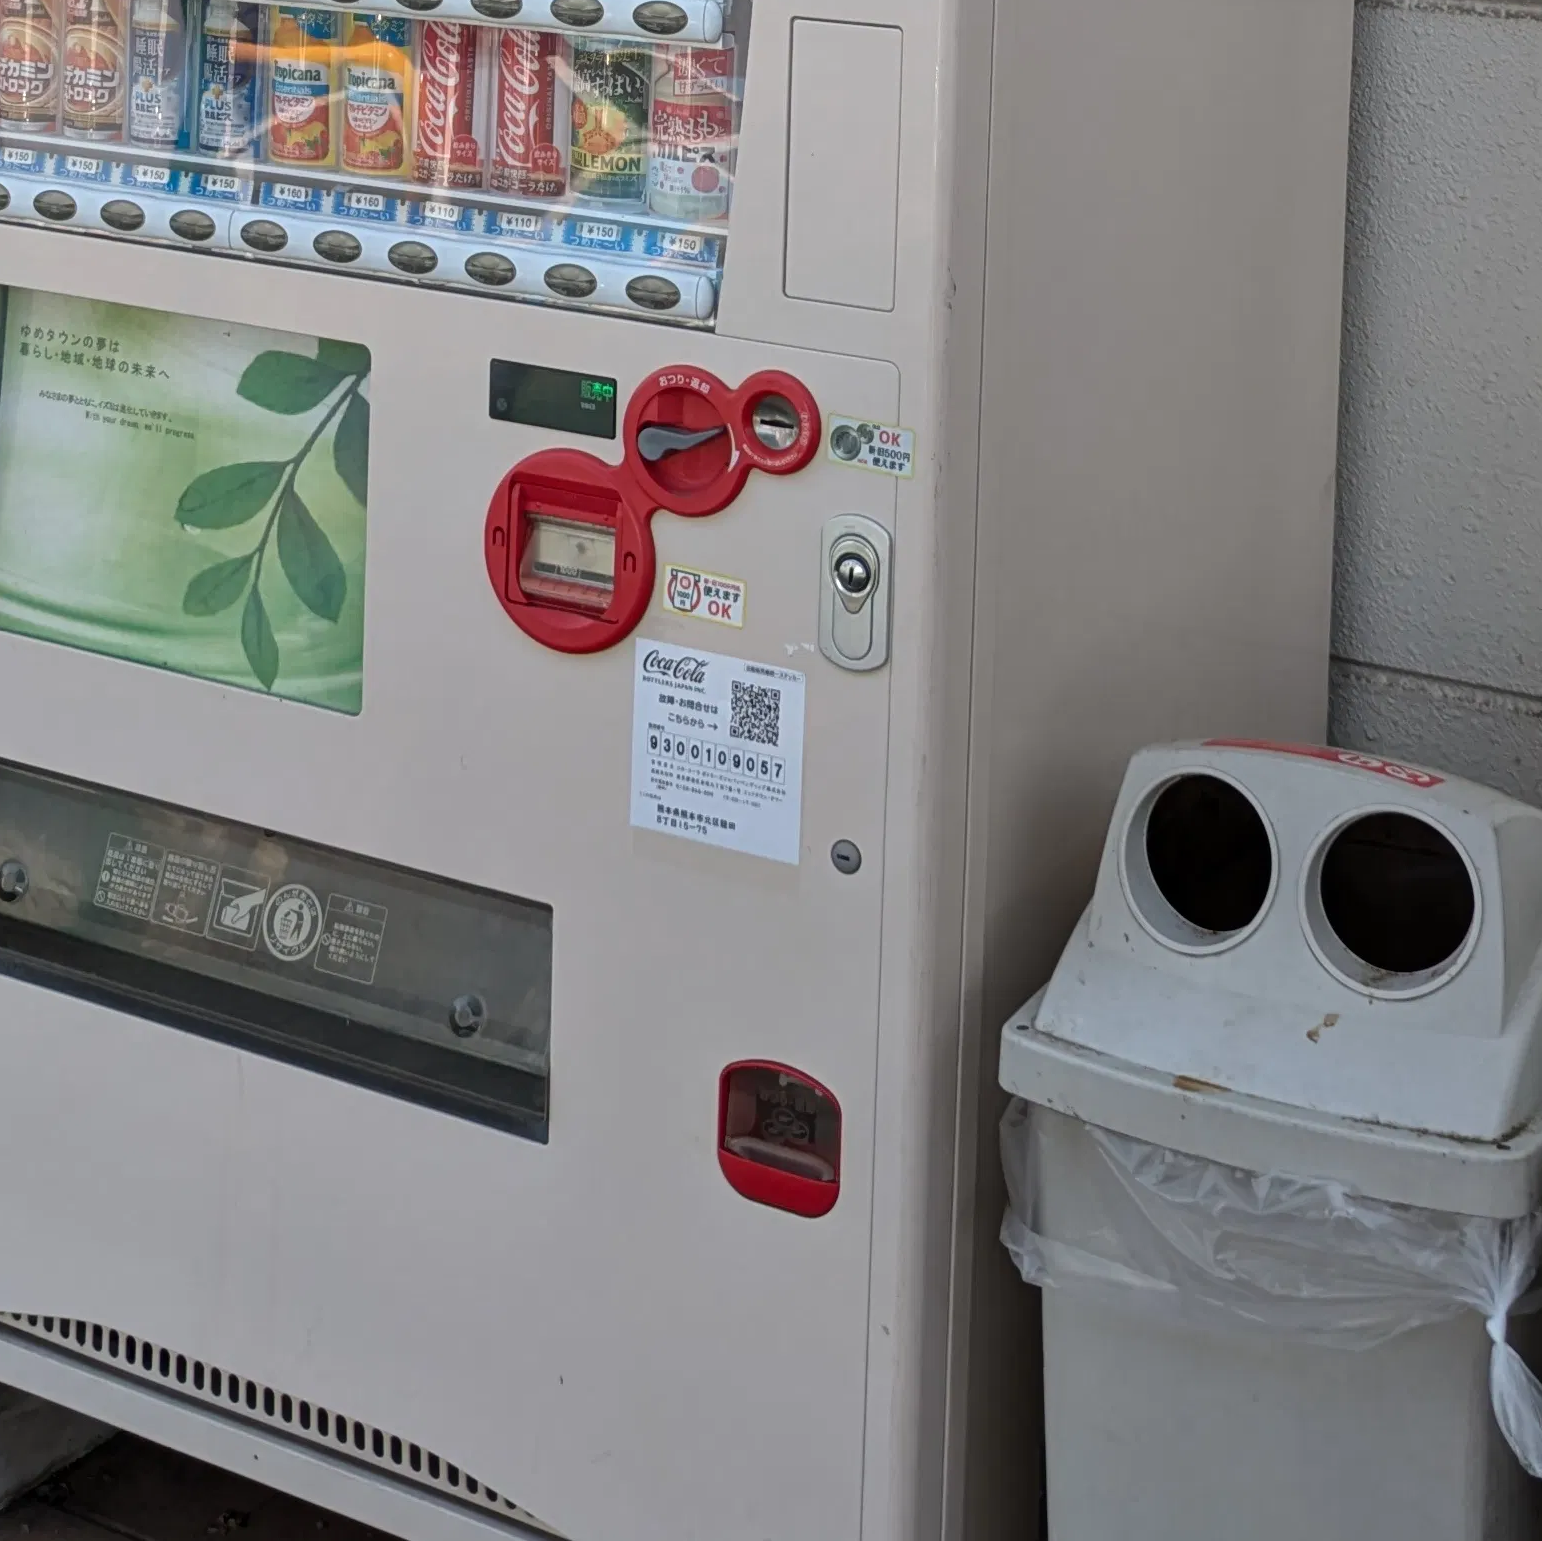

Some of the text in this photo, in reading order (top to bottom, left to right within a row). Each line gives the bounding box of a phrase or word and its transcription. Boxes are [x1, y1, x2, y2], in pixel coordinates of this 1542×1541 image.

[274, 61, 321, 82] Tropicana
[347, 68, 397, 90] Tropicana
[135, 91, 162, 104] PLUS
[204, 99, 232, 111] PLUS
[583, 155, 641, 172] LEMON
[20, 324, 121, 353] ゆめタウンの夢は
[878, 430, 903, 447] OK
[871, 458, 906, 472] 使えます
[703, 587, 741, 603] 使えます
[707, 601, 732, 620] OK
[643, 650, 709, 684] Coca-Cola
[667, 713, 705, 729] こちらから
